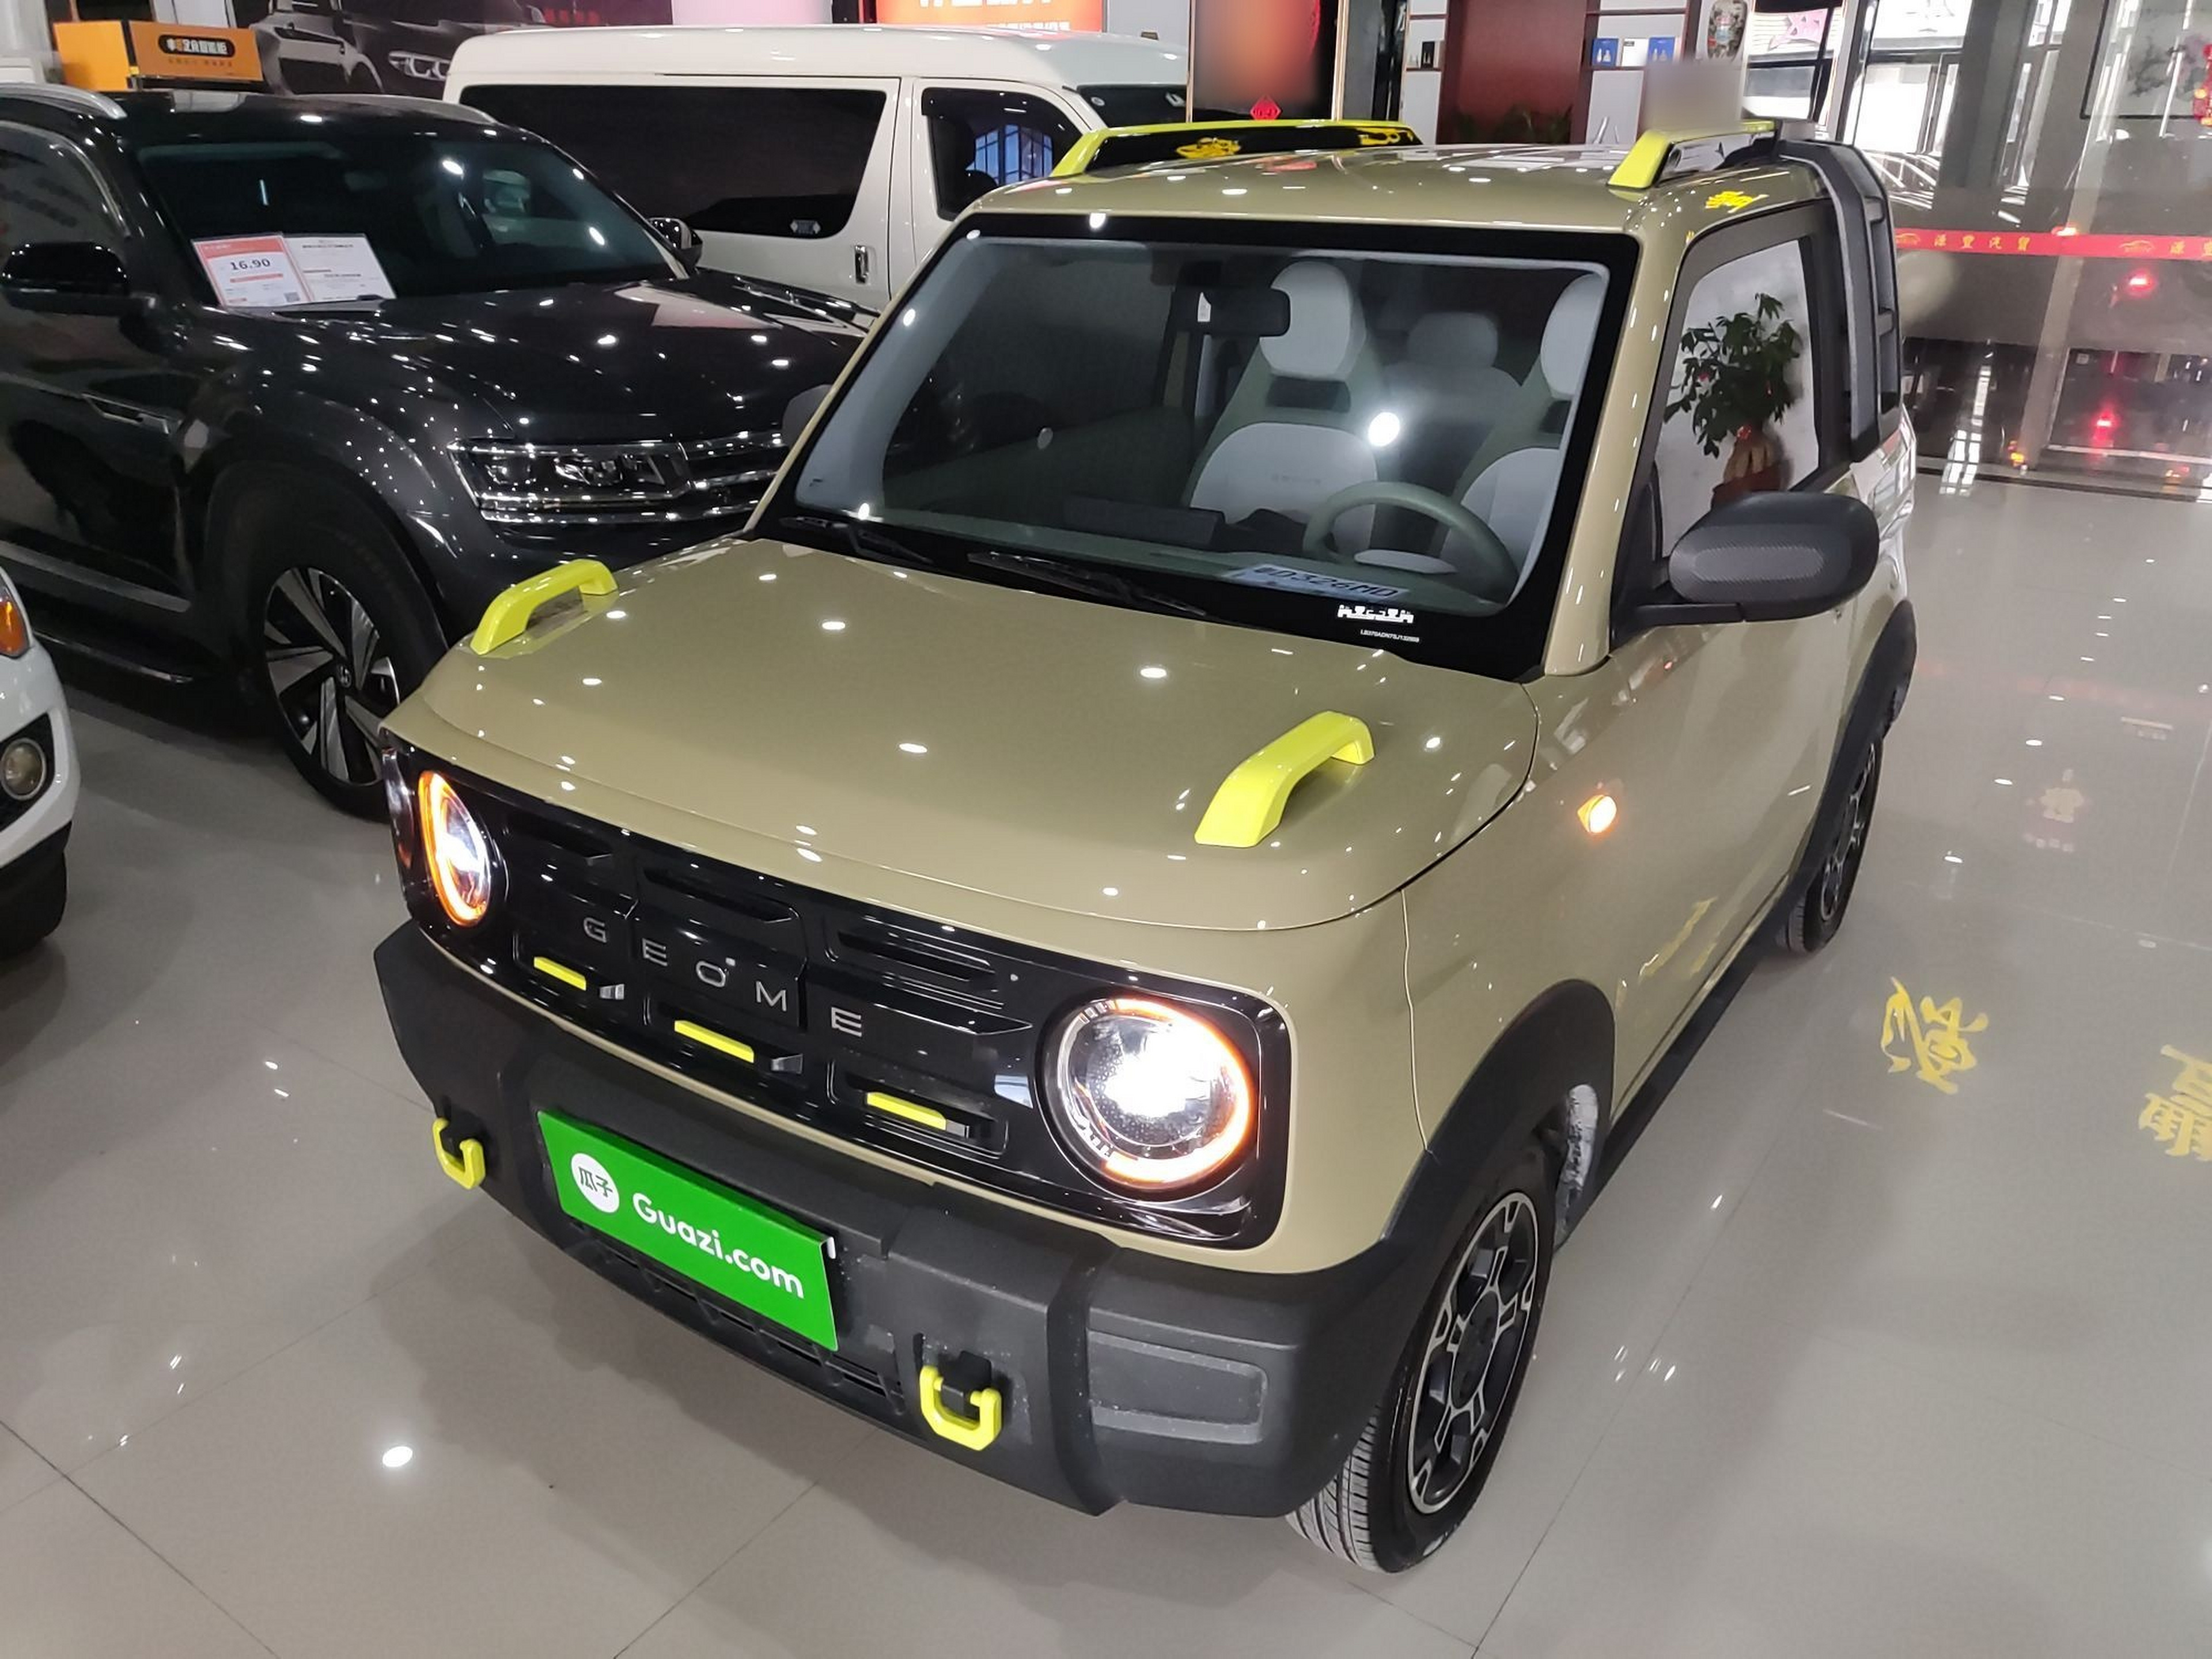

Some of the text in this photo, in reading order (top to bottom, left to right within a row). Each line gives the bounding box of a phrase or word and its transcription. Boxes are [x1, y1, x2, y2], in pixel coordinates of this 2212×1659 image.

[230, 258, 271, 271] 16.90
[583, 916, 863, 1037] GEOME
[578, 1167, 613, 1198] 瓜子
[633, 1192, 804, 1298] Guazi.com
